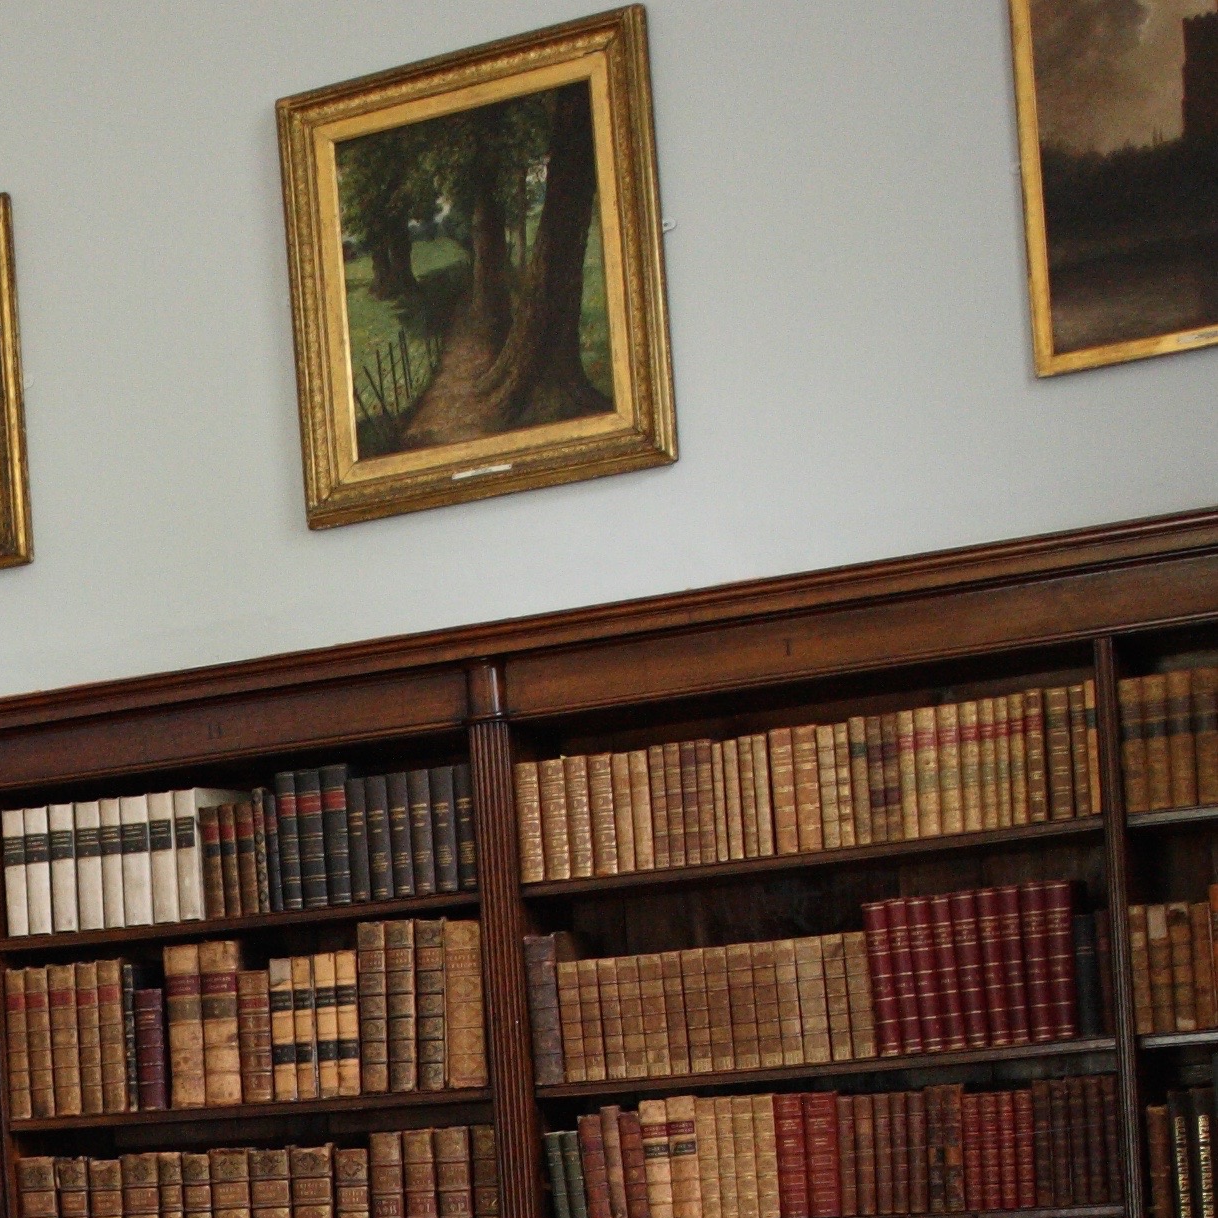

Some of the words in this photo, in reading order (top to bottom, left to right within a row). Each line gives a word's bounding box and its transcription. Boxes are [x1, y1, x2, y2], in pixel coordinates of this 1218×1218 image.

[1175, 1116, 1187, 1144] GREAT
[1198, 1114, 1210, 1143] GREAT
[1176, 1147, 1189, 1191] PICTURES
[1199, 1146, 1212, 1190] PICTURES
[1179, 1193, 1191, 1203] IN
[1202, 1192, 1214, 1203] IN
